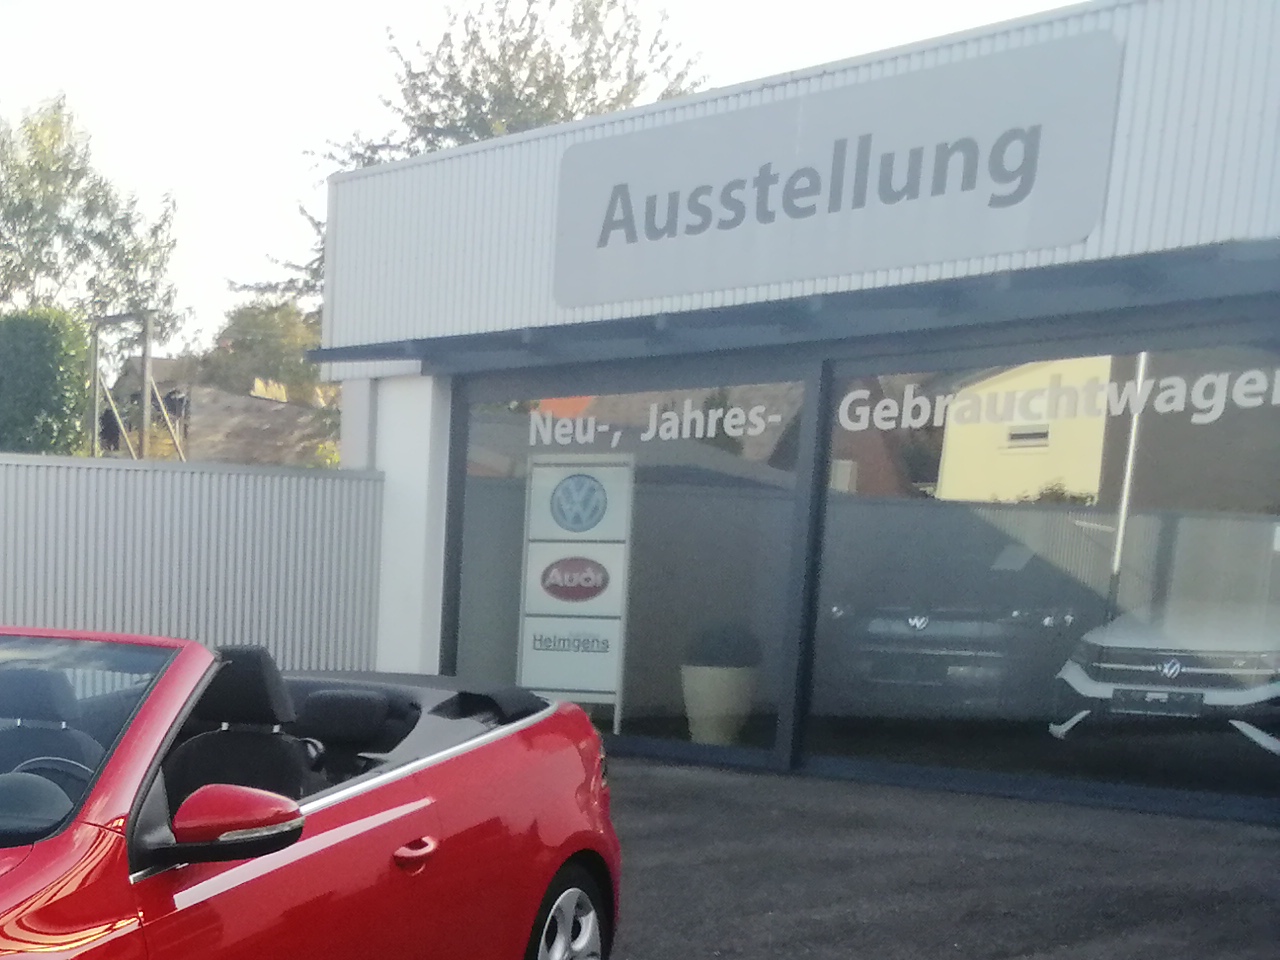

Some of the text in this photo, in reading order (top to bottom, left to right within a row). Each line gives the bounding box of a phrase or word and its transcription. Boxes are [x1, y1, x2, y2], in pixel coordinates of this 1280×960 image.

[596, 124, 1042, 248] Ausstellung
[529, 409, 622, 448] Neu-,
[640, 399, 782, 442] Jahres-
[546, 568, 604, 587] Audi
[533, 634, 609, 652] Heimgens
